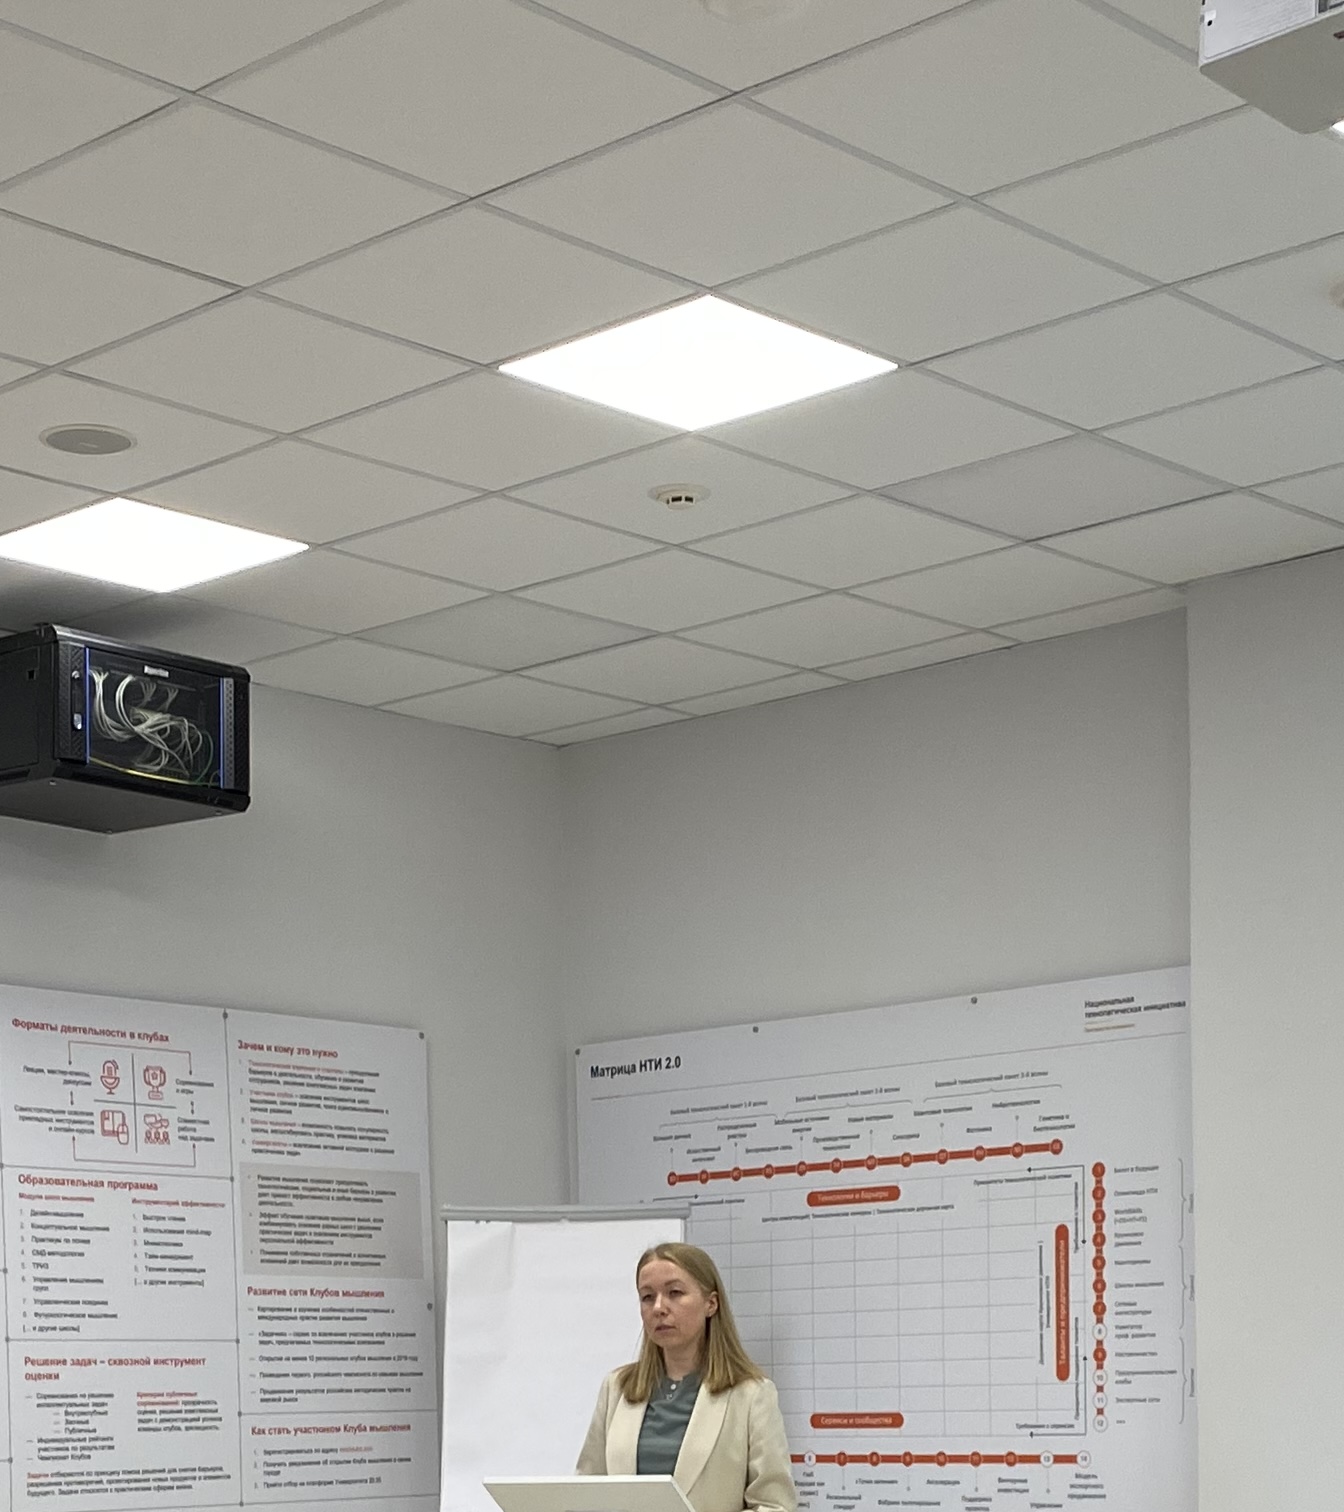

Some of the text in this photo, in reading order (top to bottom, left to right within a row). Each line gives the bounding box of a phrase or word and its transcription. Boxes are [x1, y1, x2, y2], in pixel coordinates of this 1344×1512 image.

[11, 1018, 170, 1044] Форматы деятельности в клубах
[590, 1055, 681, 1079] Матрица НТИ 2.0
[17, 1173, 159, 1192] Образовательная программа
[24, 1356, 68, 1367] Решение
[69, 1358, 98, 1368] задач
[107, 1357, 151, 1367] сквозной
[153, 1358, 206, 1368] инструмент
[24, 1372, 60, 1382] оценки
